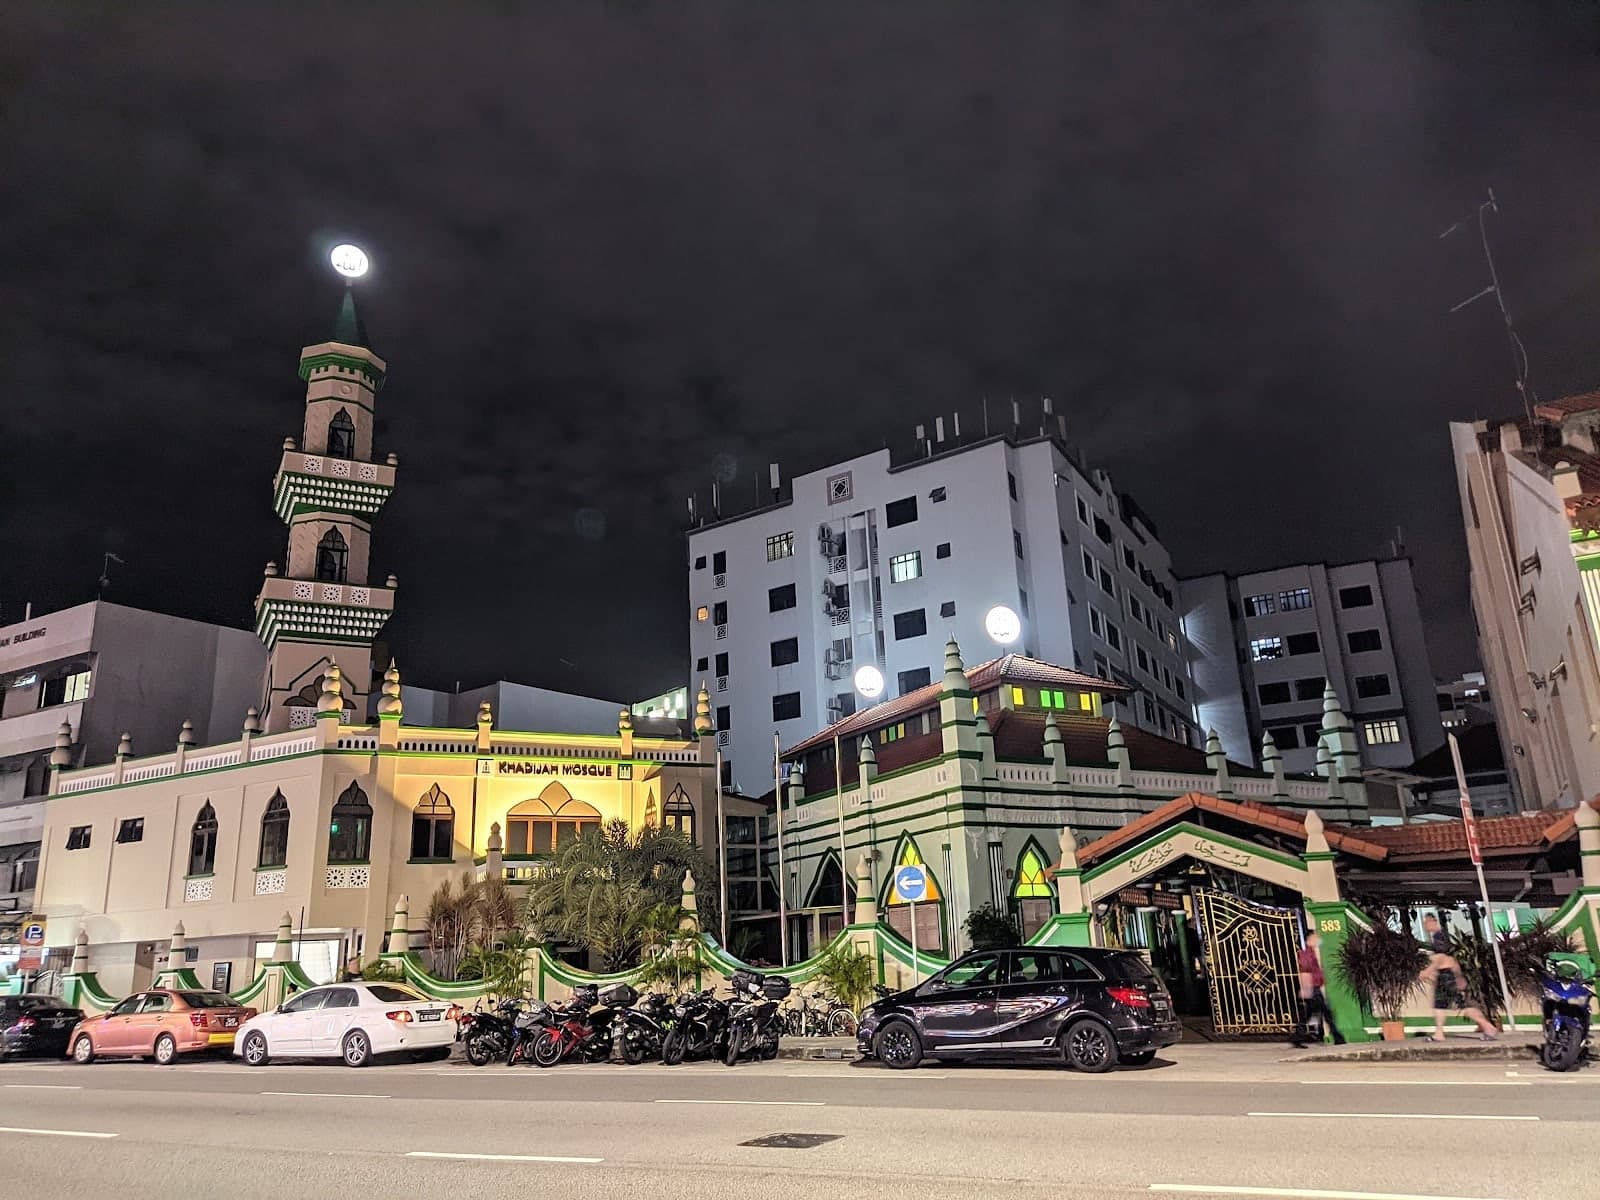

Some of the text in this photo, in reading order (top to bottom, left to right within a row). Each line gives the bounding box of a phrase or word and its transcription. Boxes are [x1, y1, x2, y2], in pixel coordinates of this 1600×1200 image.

[13, 627, 47, 644] BUILDING
[498, 761, 612, 777] KHADIJAH MOSQUE
[1320, 919, 1341, 932] 583
